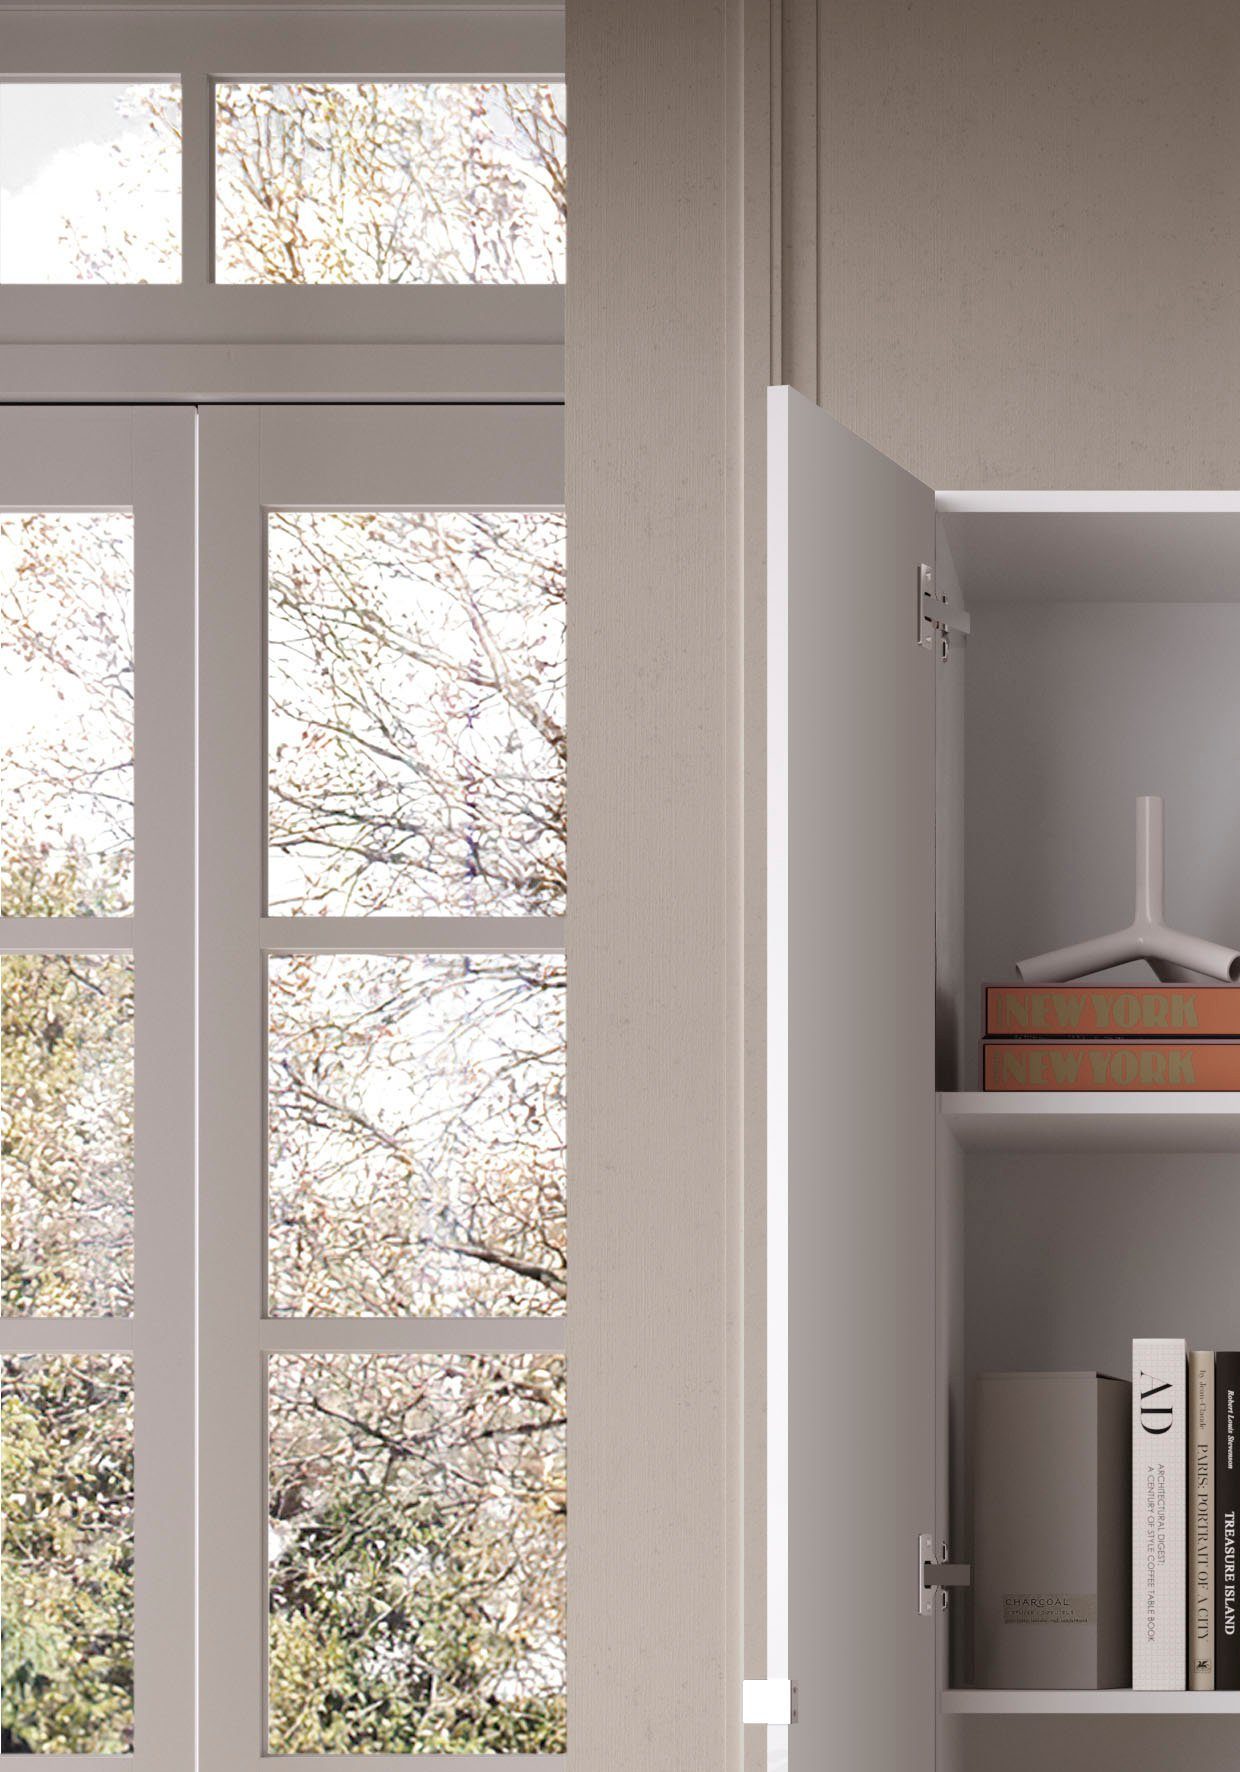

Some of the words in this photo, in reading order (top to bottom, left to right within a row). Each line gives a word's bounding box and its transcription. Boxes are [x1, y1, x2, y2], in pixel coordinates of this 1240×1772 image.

[1004, 992, 1088, 1030] NEW
[1090, 992, 1200, 1030] YORK
[1000, 1050, 1084, 1086] NEW
[1086, 1050, 1198, 1086] YORK
[1140, 1371, 1173, 1435] AD
[1197, 1444, 1208, 1488] PARIS:
[1147, 1474, 1155, 1514] CENTURY
[1157, 1464, 1166, 1532] ARCHITECTURAL
[1147, 1515, 1155, 1528] OF
[1197, 1494, 1208, 1567] PORTRAIT
[1147, 1530, 1155, 1553] STYLE
[1157, 1534, 1166, 1566] DIGEST:
[1224, 1511, 1235, 1582] TREASURE
[1147, 1554, 1156, 1588] COFFEE
[1197, 1571, 1208, 1590] OF
[1004, 1598, 1070, 1608] CHARCOAL
[1147, 1590, 1155, 1614] TABLE
[1224, 1585, 1235, 1635] ISLAND
[1147, 1616, 1156, 1642] BOOK
[1196, 1608, 1209, 1642] CITY
